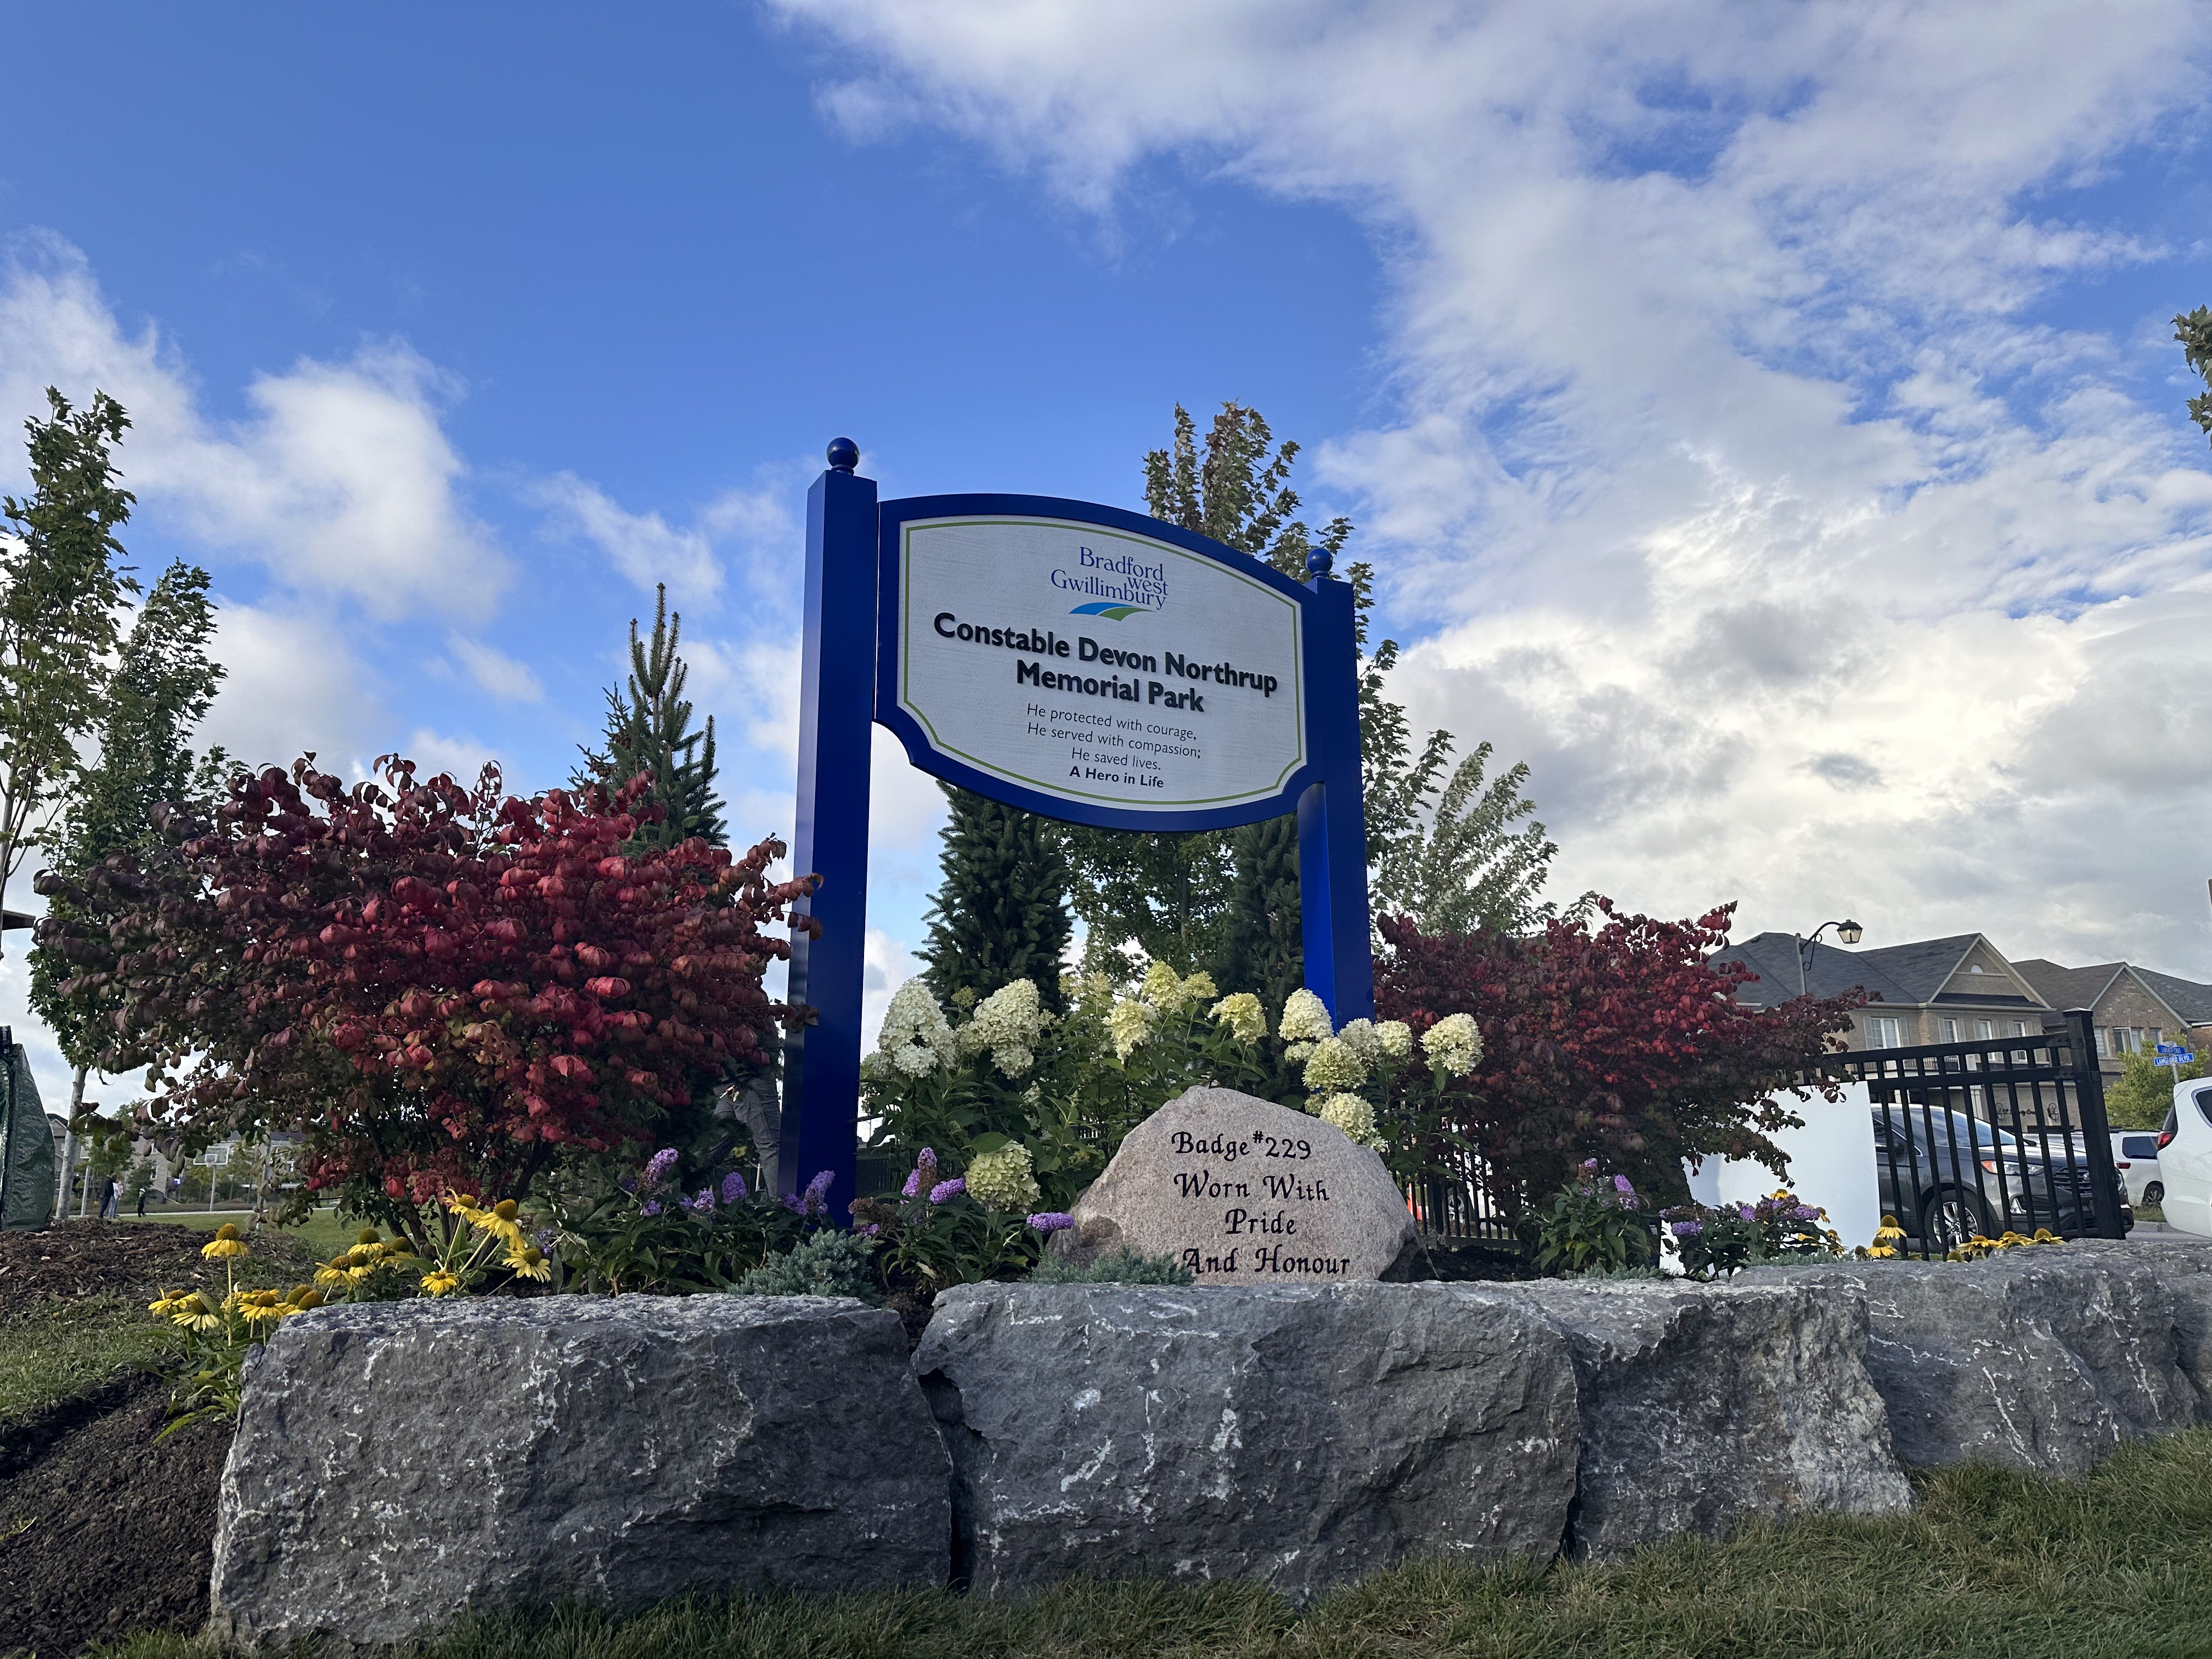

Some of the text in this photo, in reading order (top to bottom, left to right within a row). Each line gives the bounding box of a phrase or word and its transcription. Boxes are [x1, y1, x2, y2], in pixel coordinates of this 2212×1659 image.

[1079, 546, 1164, 582] Bradford
[1051, 569, 1167, 611] Gwillimbury
[1126, 577, 1169, 596] west
[934, 612, 1278, 698] Constable Devon Northrup
[1017, 659, 1205, 713] Memorial Park
[1027, 703, 1197, 742] He protected with courage,
[1028, 721, 1201, 759] He served with compassion;
[1071, 747, 1161, 770] He saved lives.
[1069, 765, 1164, 788] A Hero in Life
[1171, 1131, 1250, 1162] Badge
[1173, 1170, 1330, 1201] Worn With
[1225, 1208, 1297, 1235] Pride
[1182, 1244, 1350, 1275] And Honour
